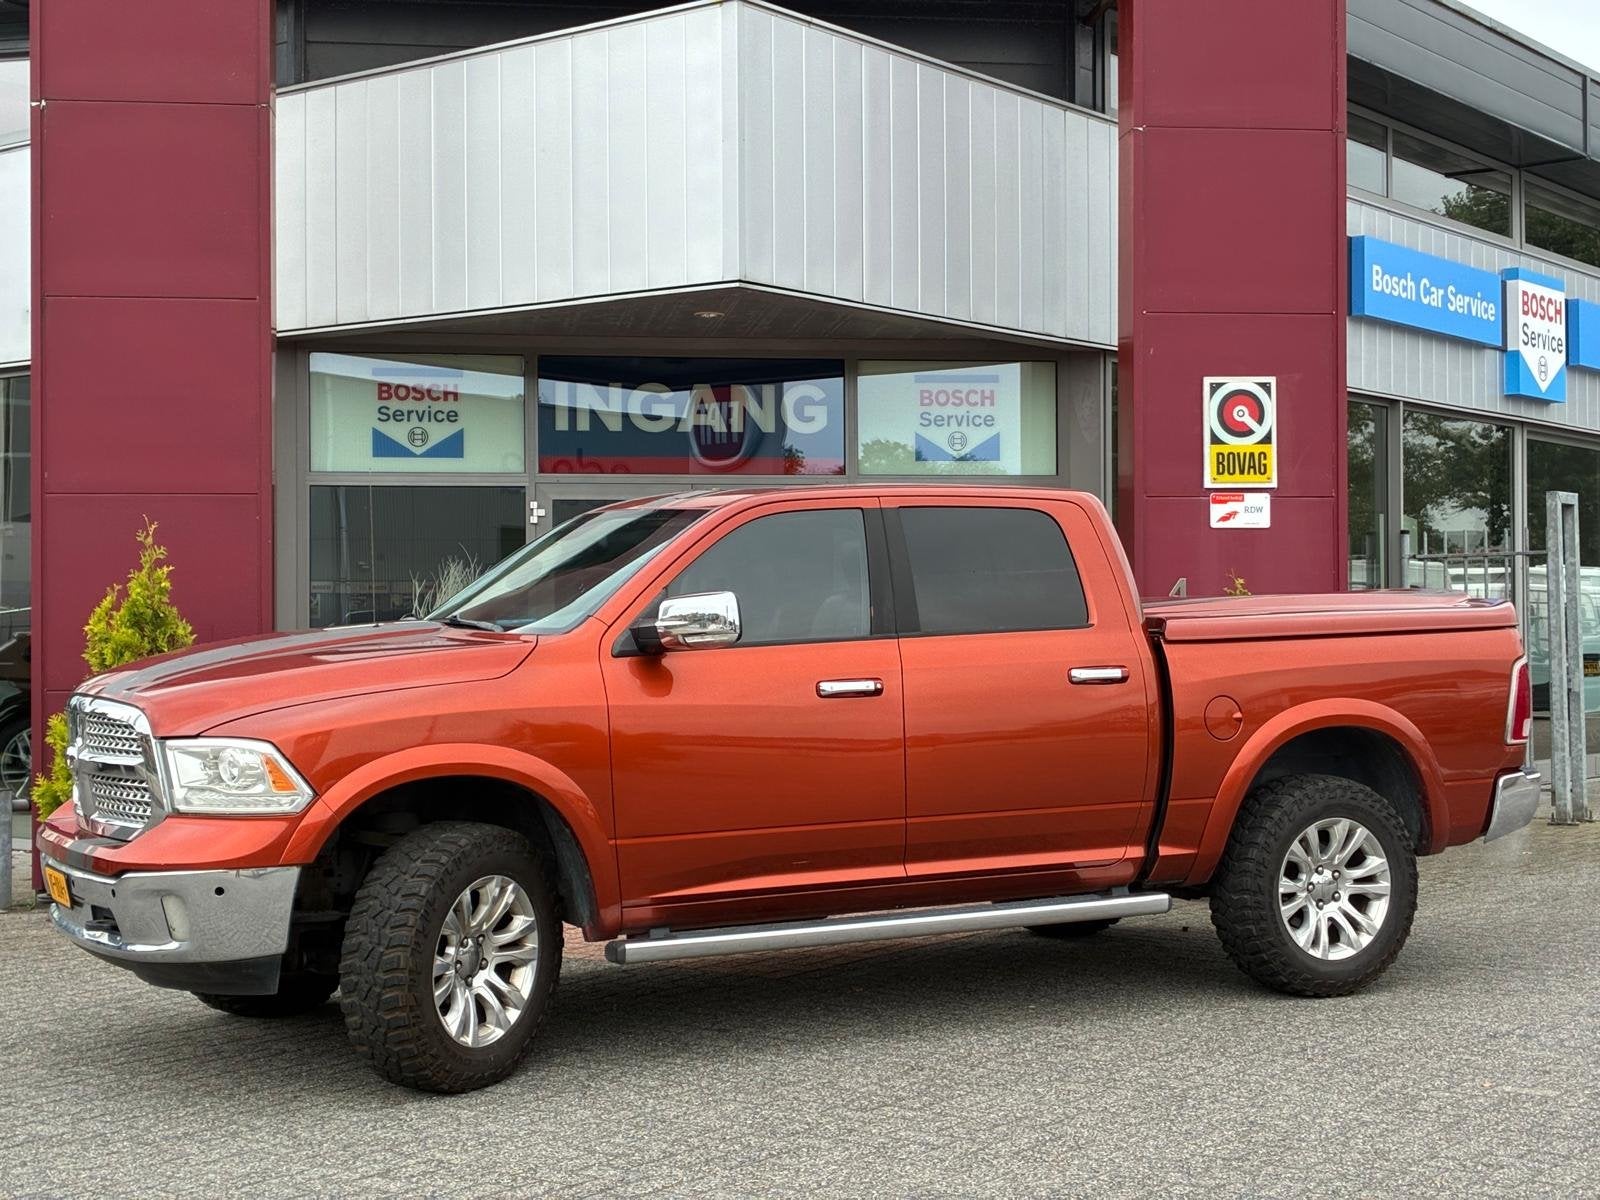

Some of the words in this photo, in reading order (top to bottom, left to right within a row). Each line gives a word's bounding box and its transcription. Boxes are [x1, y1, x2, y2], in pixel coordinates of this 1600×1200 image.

[1372, 264, 1416, 301] Bosch
[1420, 278, 1445, 309] Car
[1447, 285, 1496, 321] Service
[1521, 290, 1563, 326] BOSCH
[1521, 322, 1564, 354] Service
[377, 383, 460, 402] BOSCH
[919, 389, 995, 407] BOSCH
[377, 405, 459, 423] Service
[554, 382, 828, 434] INGANG
[919, 411, 995, 428] Service
[1216, 451, 1267, 476] BOVAG
[1169, 577, 1187, 598] 4
